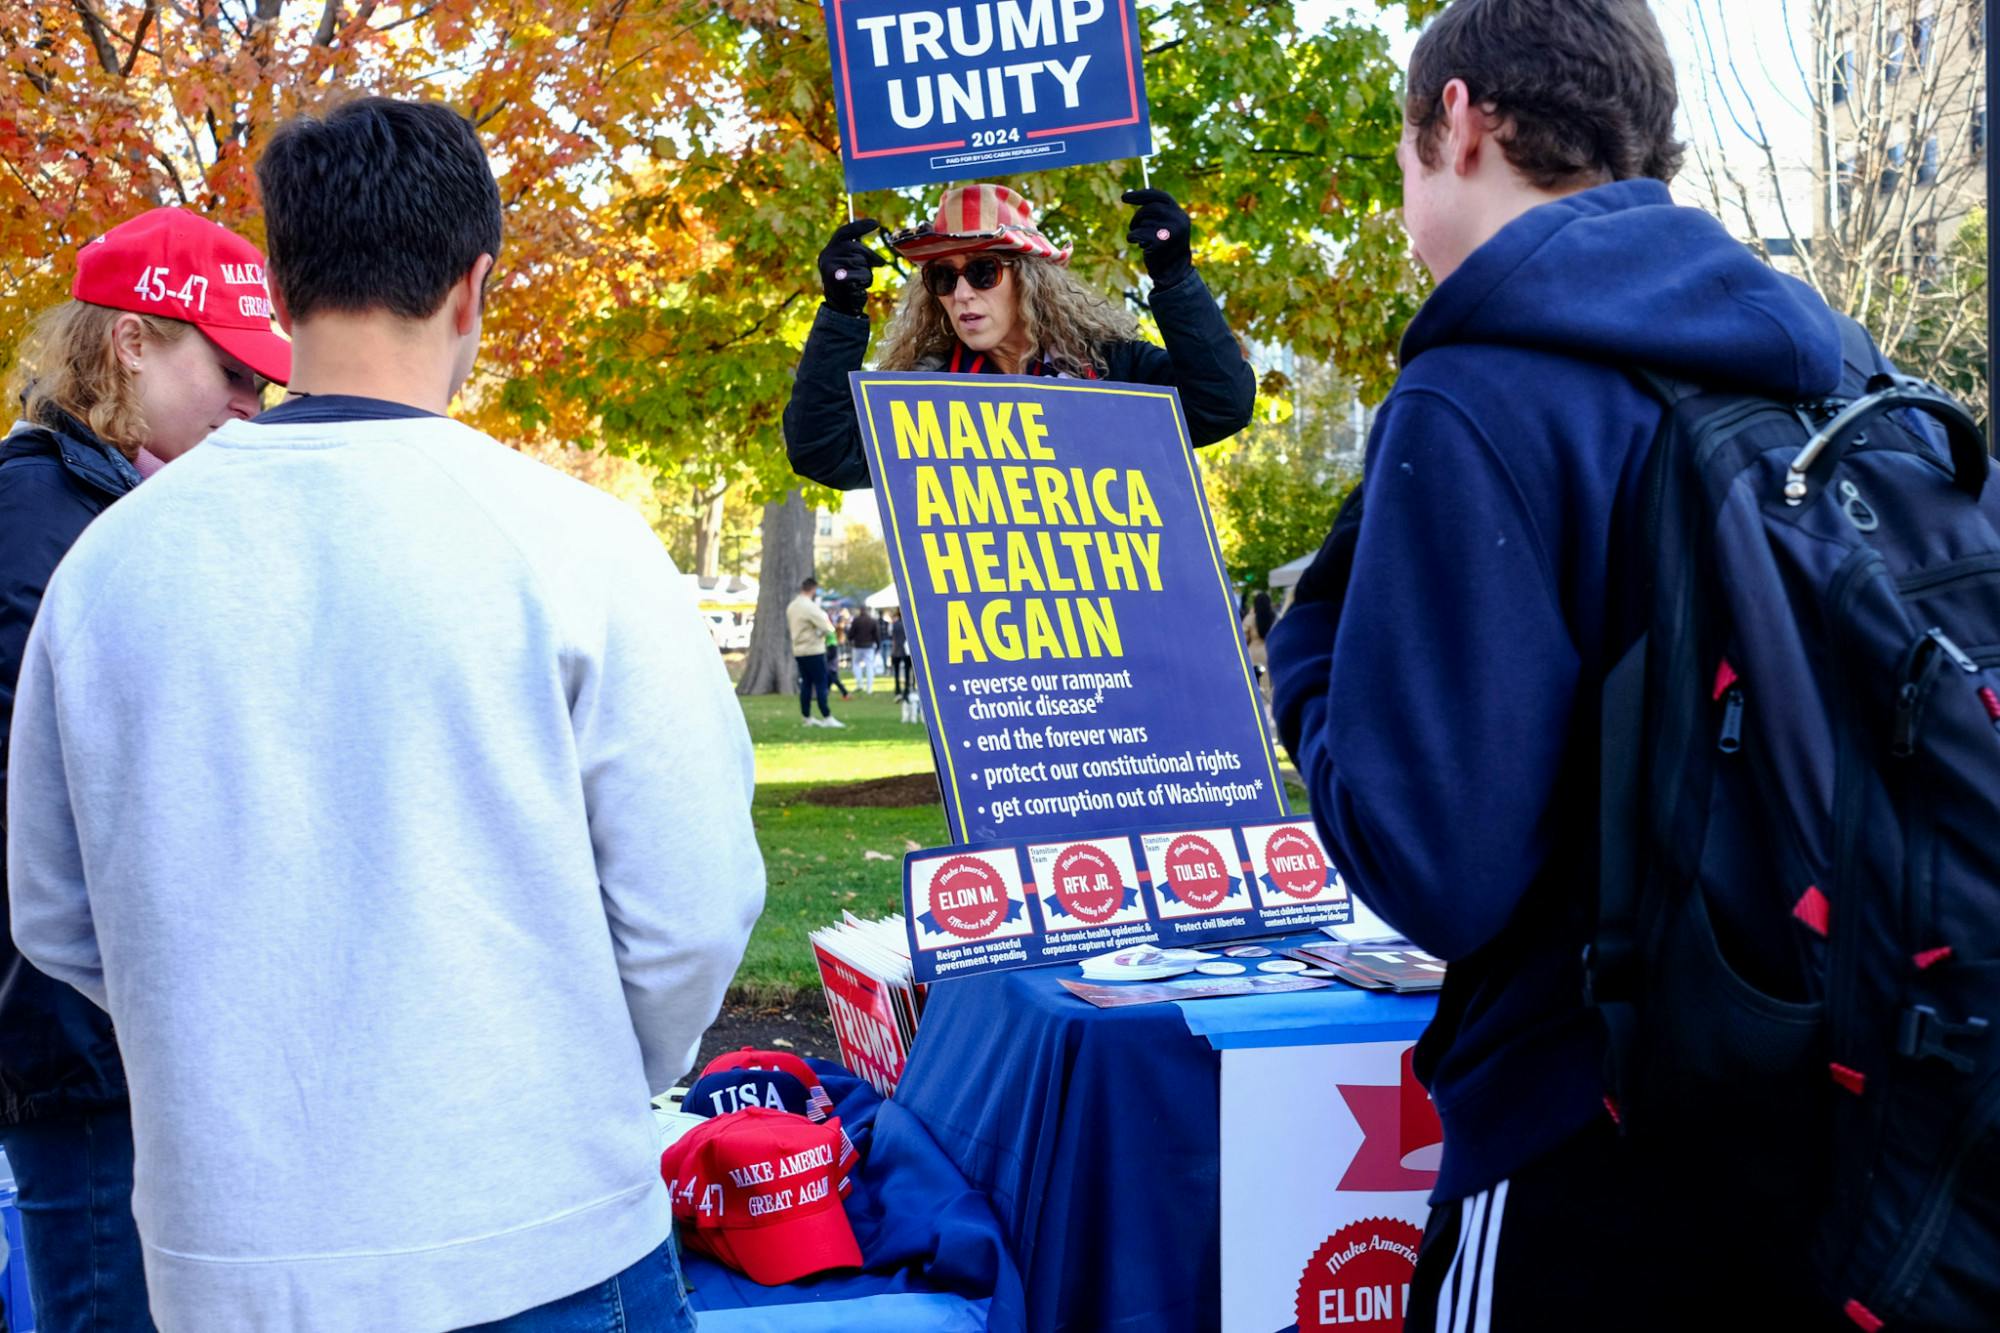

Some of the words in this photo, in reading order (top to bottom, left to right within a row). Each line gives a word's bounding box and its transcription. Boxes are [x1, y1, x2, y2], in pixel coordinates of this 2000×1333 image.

[857, 0, 1104, 67] TRUMP
[887, 55, 1092, 129] UNITY
[972, 127, 1020, 148] 2024
[946, 157, 960, 165] PAID
[981, 153, 993, 161] LOG
[994, 150, 1010, 159] CABIN
[134, 265, 208, 312] 45-47
[889, 400, 1056, 460] MAKE
[916, 465, 1164, 528] AMERICA
[921, 530, 1164, 595] HEALTHY
[947, 597, 1124, 665] AGAIN
[963, 675, 1028, 695] reverse
[1031, 674, 1058, 692] our
[1061, 669, 1133, 697] rampant
[969, 695, 1034, 720] chronic
[977, 728, 1012, 752] end
[1013, 727, 1044, 750] the
[1045, 725, 1105, 748] forever
[1108, 725, 1149, 745] wars
[984, 761, 1048, 790] protect
[1050, 761, 1079, 781] our
[1082, 750, 1194, 778] constitutional
[1196, 749, 1241, 776] rights
[991, 800, 1022, 824] get
[1025, 789, 1114, 817] corruption
[1117, 788, 1146, 808] out
[1148, 784, 1165, 806] of
[939, 867, 958, 886] Make
[959, 864, 988, 880] America
[1173, 863, 1207, 882] TULSI
[1207, 862, 1221, 879] G.
[1271, 854, 1307, 873] VIVEK
[1306, 853, 1320, 870] R.
[938, 887, 978, 910] ELON
[979, 885, 999, 904] M.
[1062, 875, 1090, 895] RFK
[1093, 873, 1113, 891] JR.
[947, 915, 979, 930] Efficient
[980, 910, 998, 928] Again
[1071, 900, 1098, 917] Healthy
[1098, 897, 1114, 914] Again
[1259, 909, 1280, 918] Protect
[1280, 905, 1303, 916] children
[1044, 933, 1060, 944] End
[1061, 930, 1087, 942] chronic
[1087, 927, 1111, 939] health
[1112, 924, 1143, 937] epidemic
[1144, 922, 1152, 932] &
[1174, 922, 1202, 933] Protect
[1202, 918, 1217, 930] civil
[1216, 916, 1246, 929] liberties
[936, 949, 962, 961] Reign
[963, 947, 973, 956] in
[973, 945, 985, 955] on
[986, 938, 1021, 952] wasteful
[1042, 944, 1077, 956] corporate
[1078, 941, 1106, 953] capture
[1106, 938, 1115, 947] of
[1115, 933, 1159, 949] government
[935, 955, 989, 975] government
[989, 950, 1027, 964] spending
[826, 986, 898, 1079] TRUMP
[709, 1081, 788, 1116] USA
[729, 1161, 775, 1188] MAKE
[696, 1184, 724, 1217] 47
[748, 1189, 793, 1217] GREAT
[1325, 1241, 1367, 1275] Make
[1368, 1234, 1419, 1268] Americ
[1318, 1284, 1393, 1325] ELON
